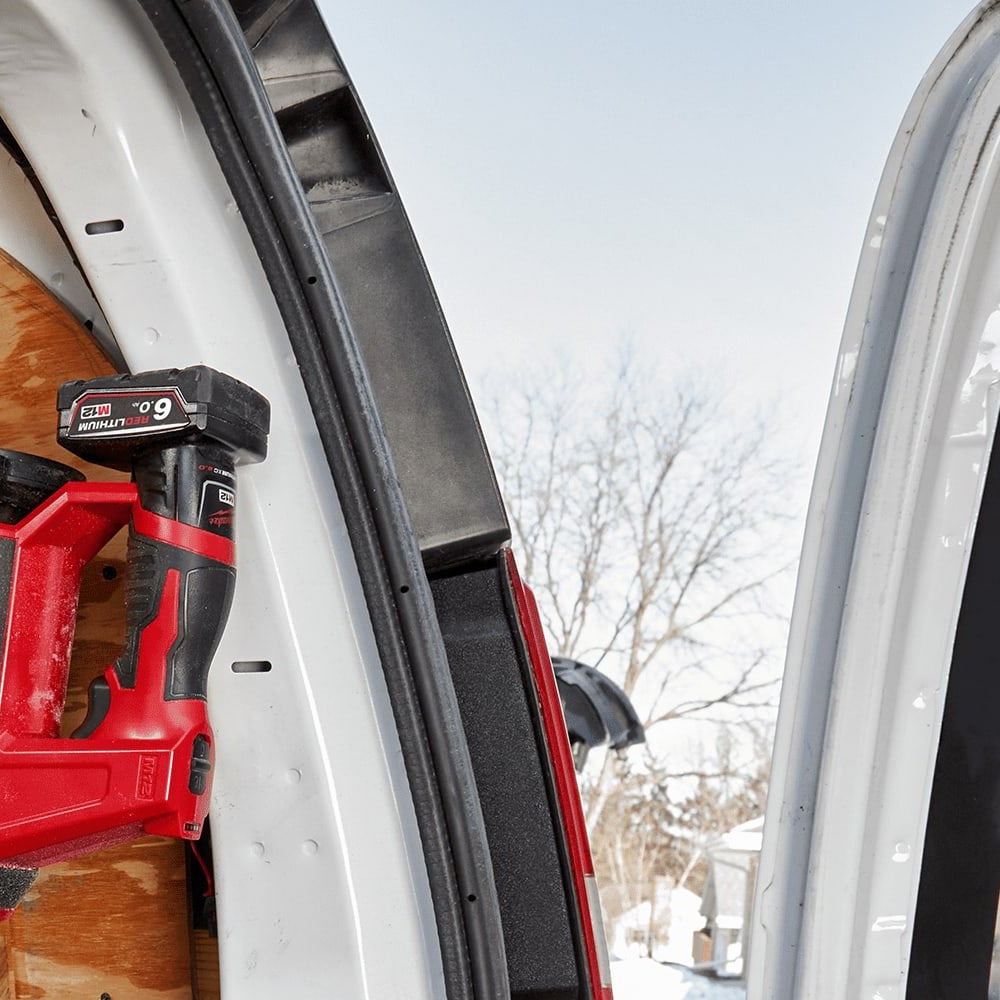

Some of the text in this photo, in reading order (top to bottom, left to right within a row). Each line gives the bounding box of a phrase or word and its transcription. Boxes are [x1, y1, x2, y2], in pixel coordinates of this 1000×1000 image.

[82, 404, 111, 418] M12
[138, 398, 172, 420] 6.0
[78, 415, 149, 432] REDLITHIUM
